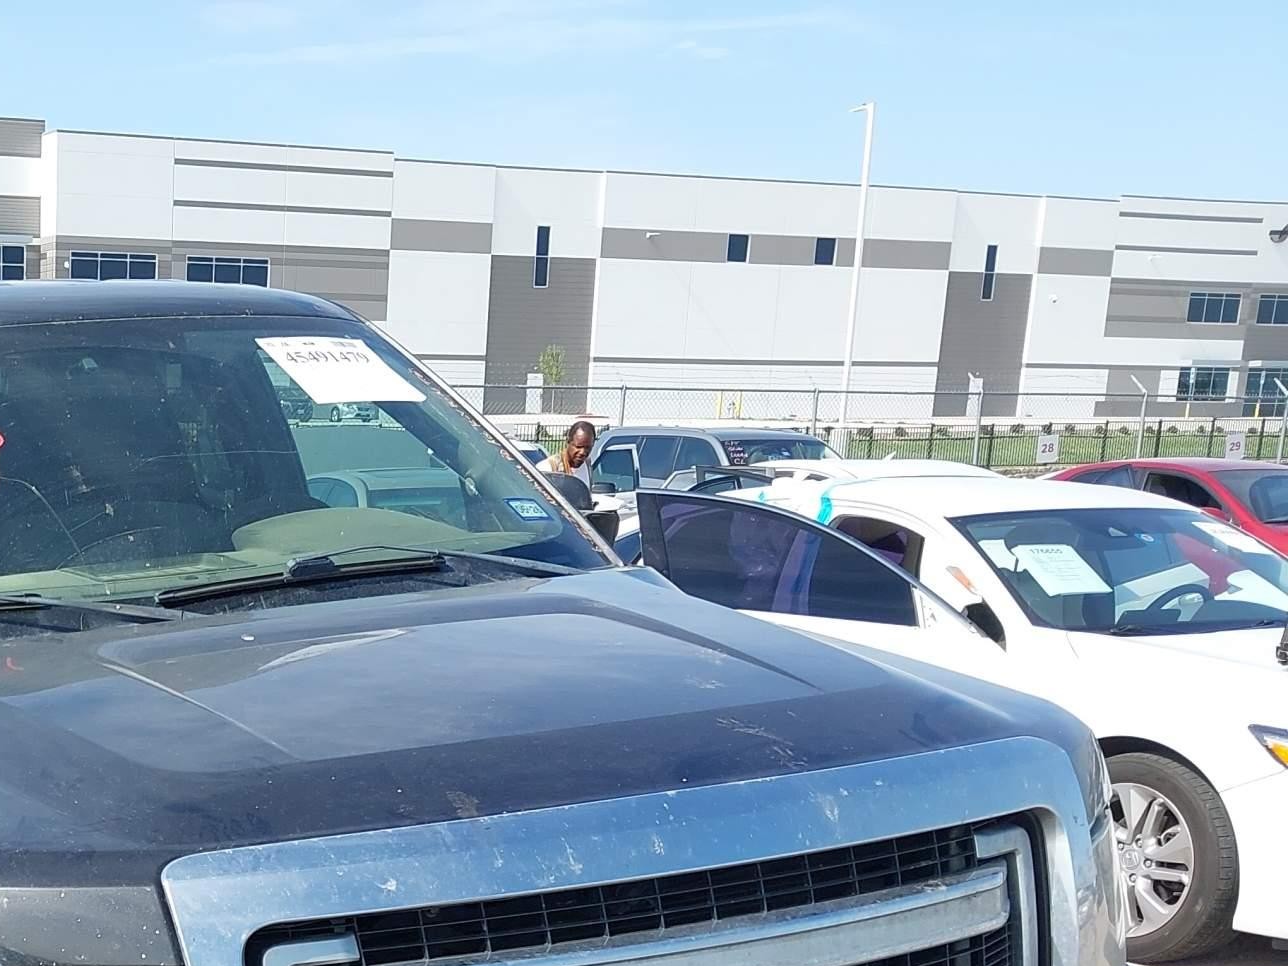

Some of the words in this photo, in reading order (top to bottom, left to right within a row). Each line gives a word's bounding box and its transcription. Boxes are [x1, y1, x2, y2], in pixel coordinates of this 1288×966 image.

[286, 351, 370, 364] 45491479
[1041, 443, 1054, 453] 28
[1229, 441, 1241, 451] 29
